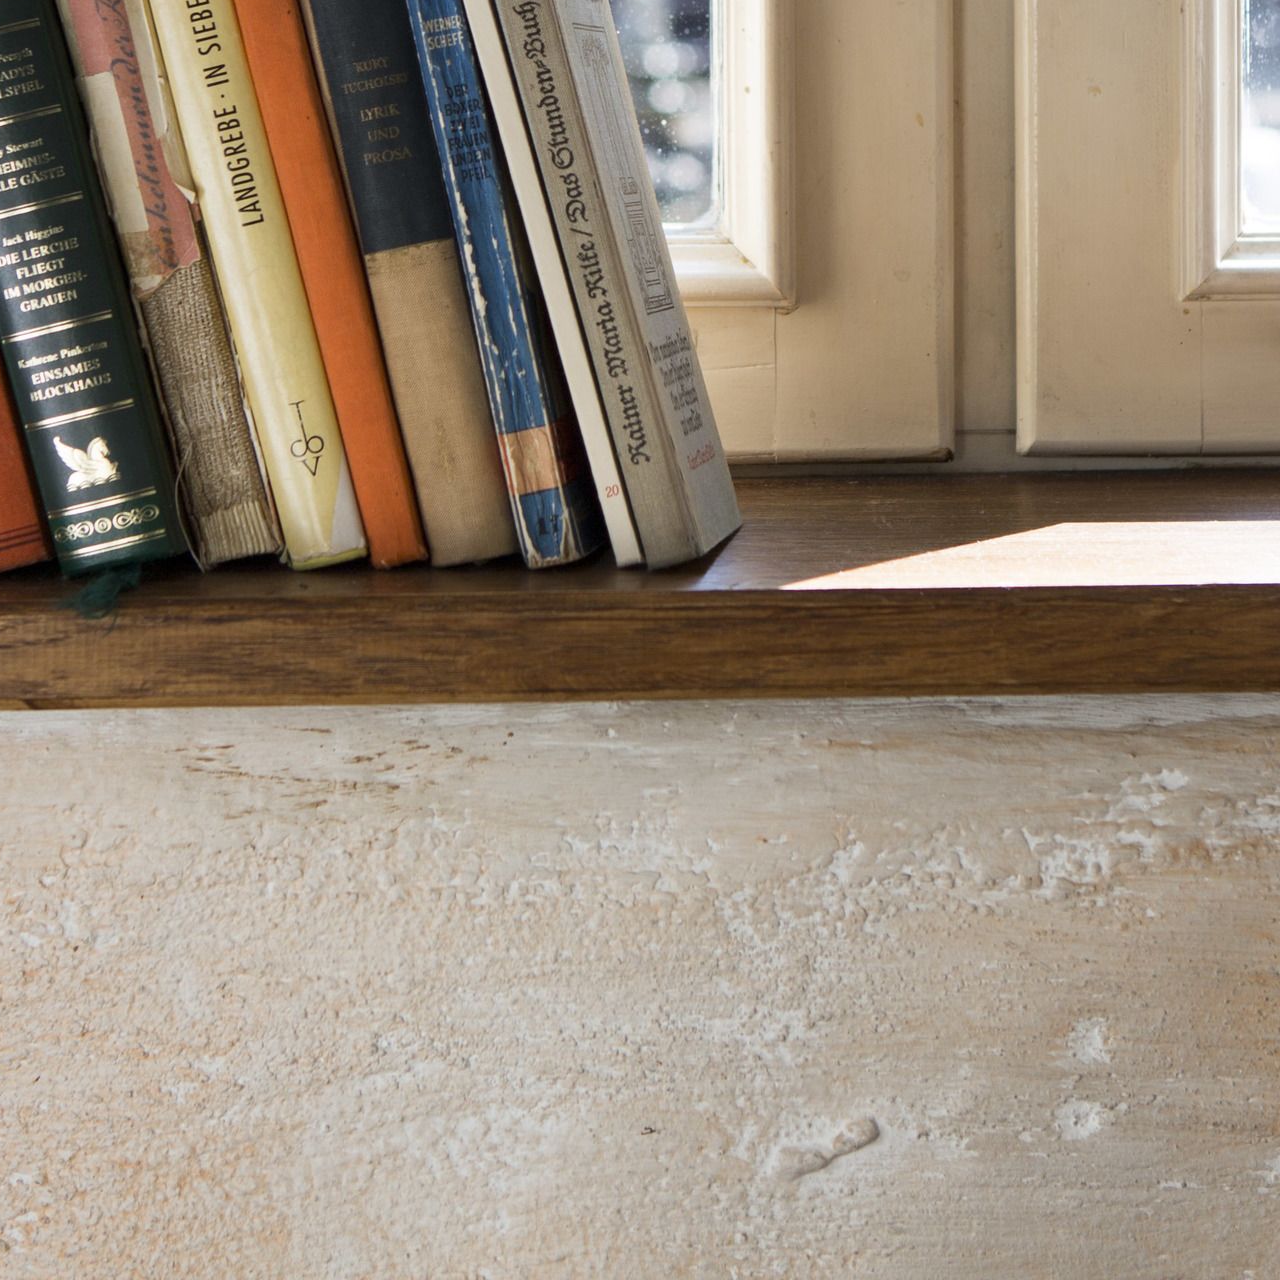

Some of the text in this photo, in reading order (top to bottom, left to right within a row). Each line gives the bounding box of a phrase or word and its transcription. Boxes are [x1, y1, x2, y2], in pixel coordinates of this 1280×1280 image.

[423, 16, 464, 33] WERNER
[428, 32, 464, 50] SCHEFF
[203, 63, 230, 87] IN
[447, 84, 468, 98] DER
[360, 104, 401, 122] LYRIK
[451, 116, 481, 132] ZWEI
[367, 126, 400, 141] UND
[449, 134, 488, 151] FRAUEN
[5, 137, 44, 154] Stewart
[363, 146, 412, 166] PROSA
[20, 166, 66, 187] GÄSTE
[214, 104, 264, 227] LANDGREBE
[564, 173, 588, 224] Das
[2, 224, 64, 248] Jack Higgins
[22, 237, 80, 262] LERCHE
[16, 258, 66, 280] FLIEGT
[584, 239, 611, 303] Rilke
[3, 271, 89, 300] IM MORGEN-
[20, 290, 78, 313] GRAUEN
[17, 341, 108, 369] Kathrene Pinkerton
[599, 317, 629, 377] Maria
[31, 358, 101, 385] EINSAMES
[30, 373, 112, 402] BLOCKHAUS
[620, 384, 651, 466] Rainer
[605, 484, 619, 499] 20
